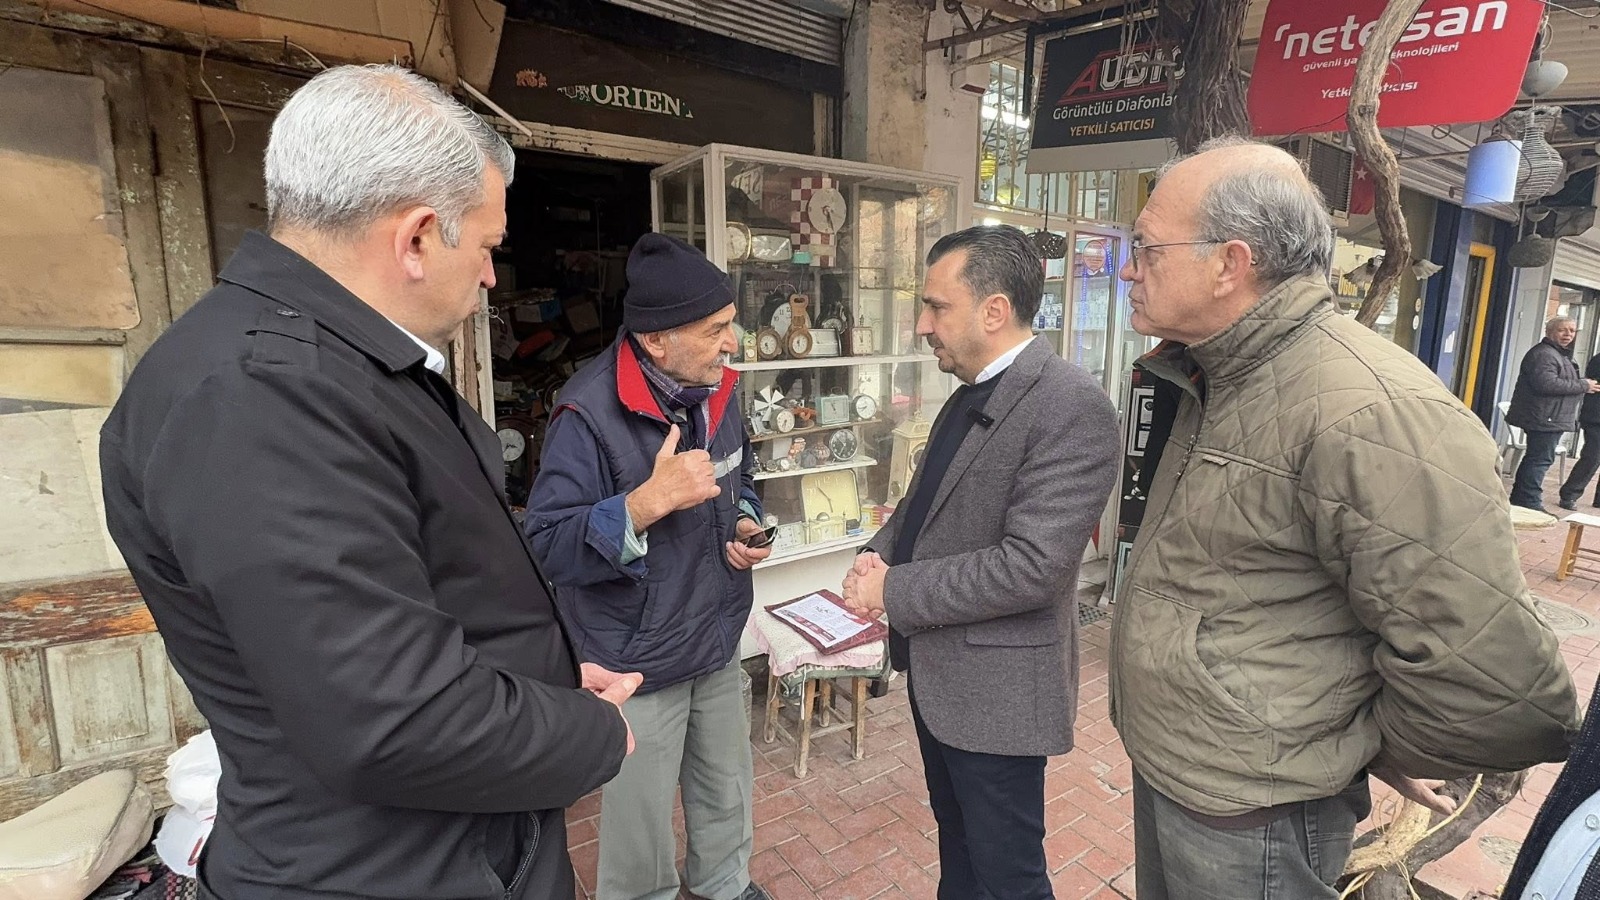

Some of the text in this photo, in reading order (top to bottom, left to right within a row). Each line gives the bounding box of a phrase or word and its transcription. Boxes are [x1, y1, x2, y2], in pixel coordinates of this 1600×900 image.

[1274, 0, 1507, 59] netesan
[1303, 58, 1341, 72] güvenli
[1390, 41, 1459, 60] eknolojileri
[1053, 101, 1112, 120] Görüntülü
[1070, 118, 1155, 136] YETKİLİ SATICISI
